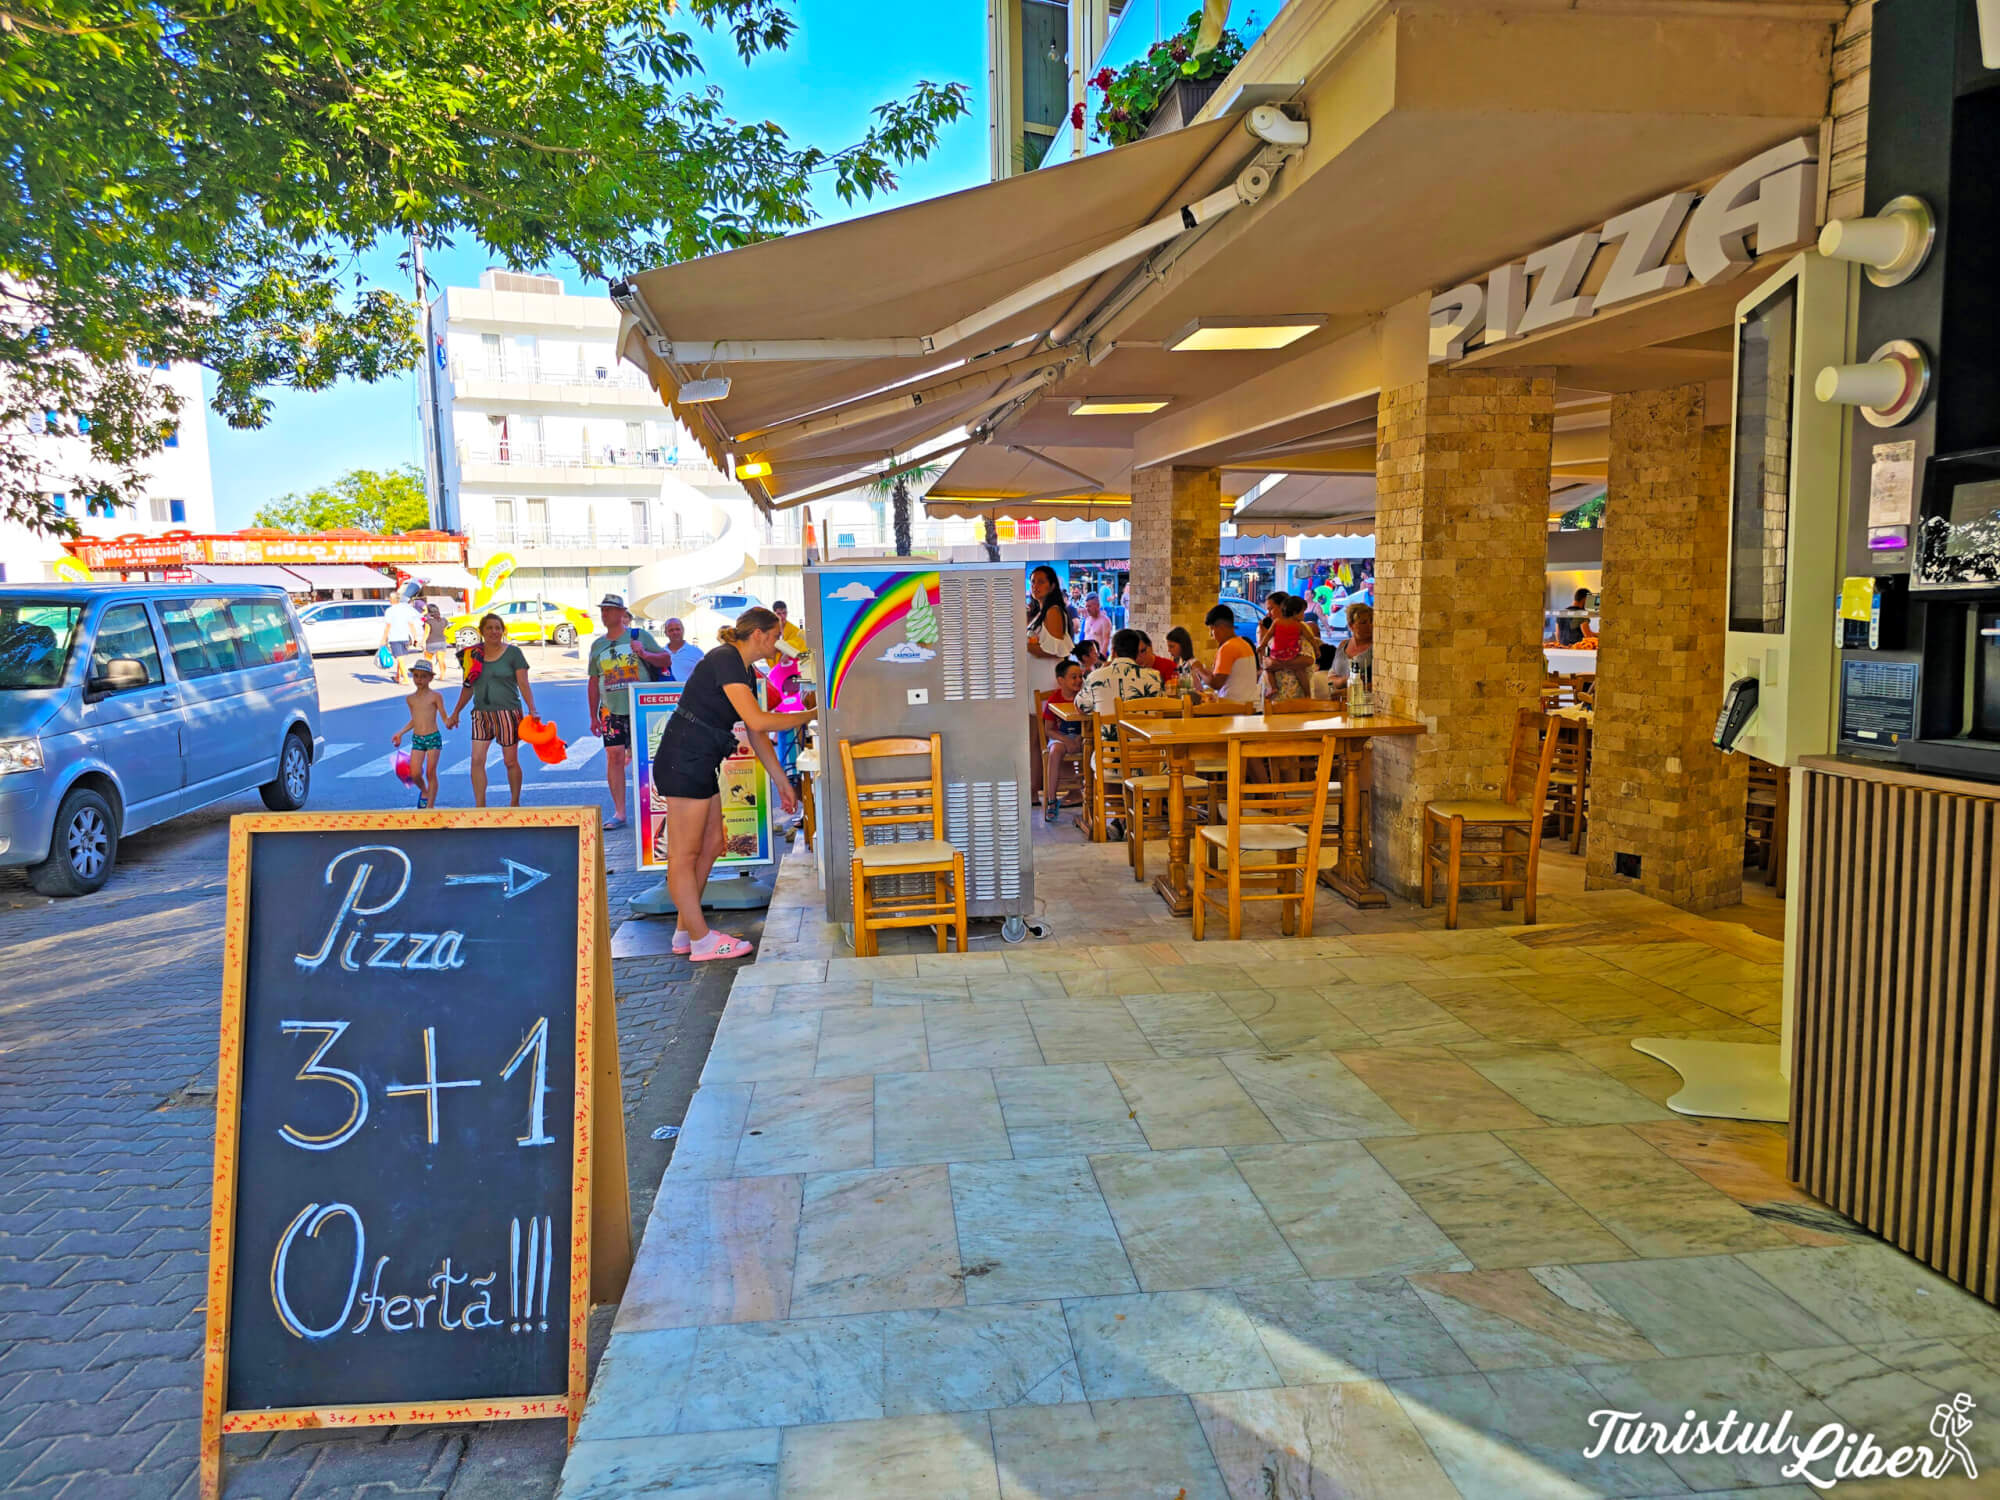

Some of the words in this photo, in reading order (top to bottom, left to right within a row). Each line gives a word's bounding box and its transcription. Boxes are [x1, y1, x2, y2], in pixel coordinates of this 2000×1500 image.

[1428, 136, 1819, 364] PIZZA
[103, 546, 132, 559] HÜSO
[134, 542, 180, 557] TURKISH
[658, 695, 681, 703] CREA
[295, 845, 465, 971] Pizza
